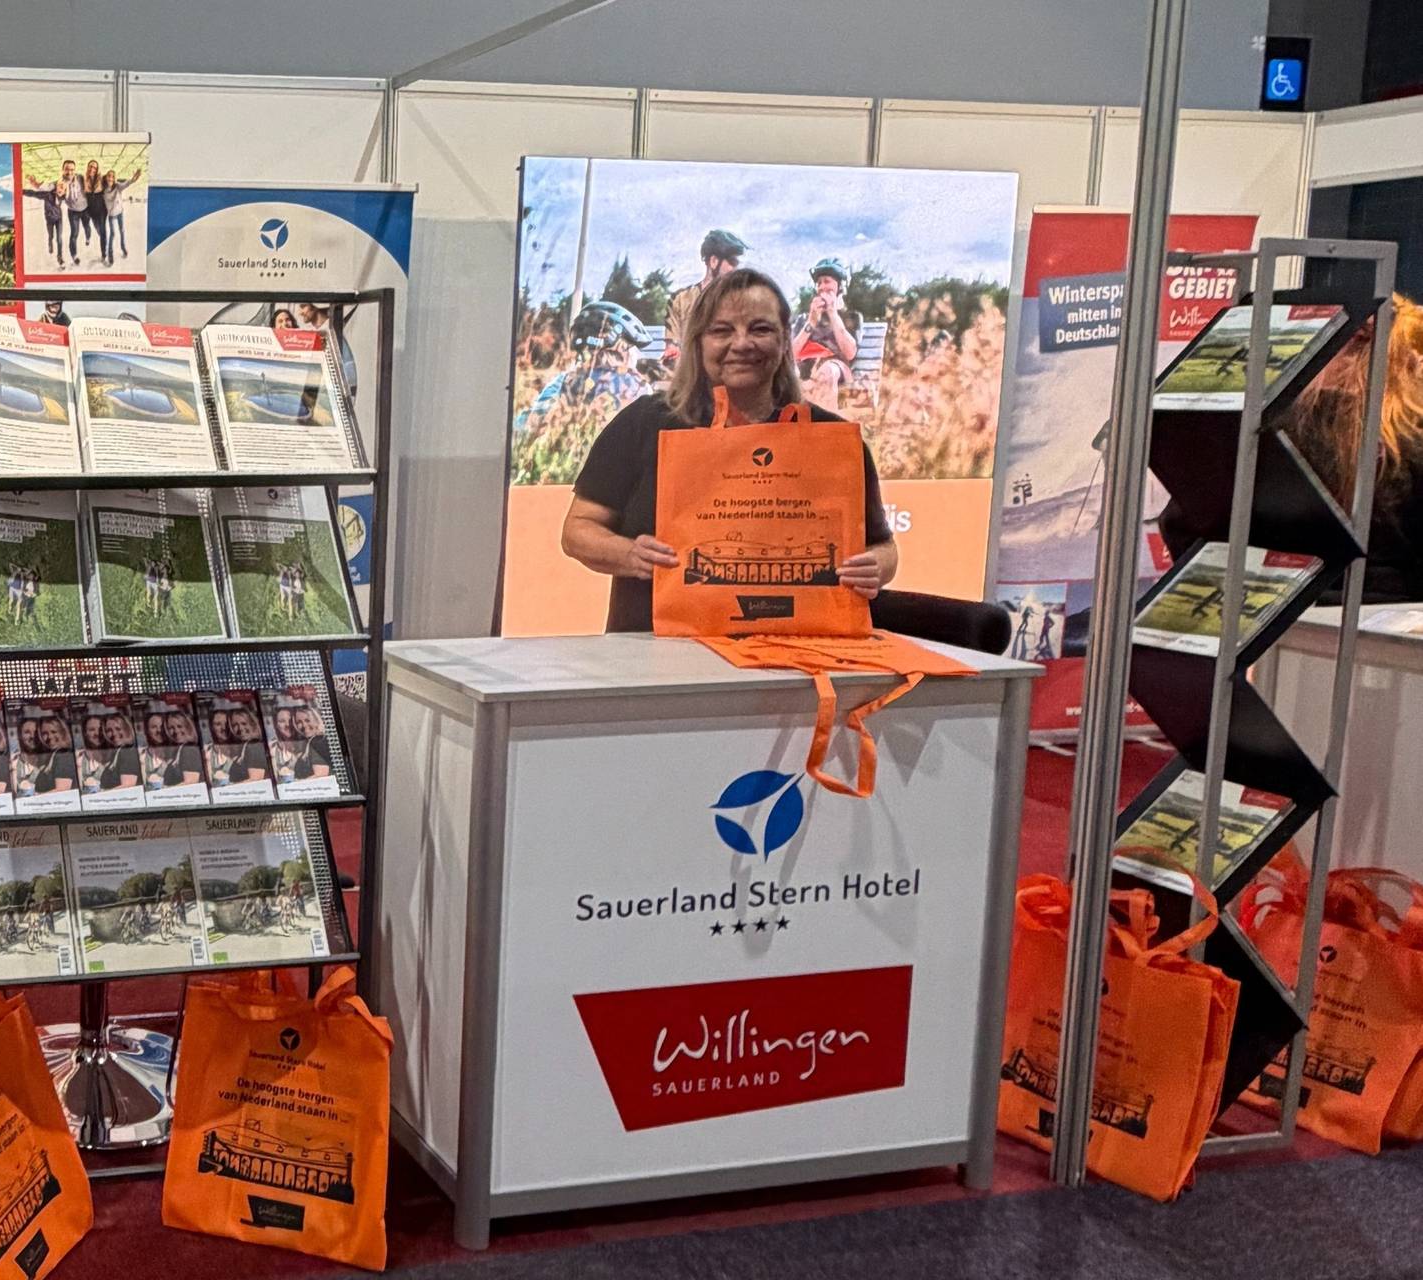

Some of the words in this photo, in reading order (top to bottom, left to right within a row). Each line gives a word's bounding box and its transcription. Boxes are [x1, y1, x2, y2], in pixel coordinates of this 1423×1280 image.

[218, 257, 268, 269] Sauerland
[271, 257, 298, 269] Stern
[300, 257, 327, 270] Hotel
[1169, 277, 1237, 300] GEBIET
[1067, 306, 1108, 324] mitten
[1055, 324, 1120, 344] Deutschla
[713, 498, 727, 508] De
[730, 497, 773, 509] hoogste
[776, 498, 812, 509] bergen
[696, 511, 716, 520] van
[718, 509, 774, 520] Nederland
[776, 510, 804, 520] staan
[806, 509, 817, 520] in
[85, 824, 139, 838] SAUERLAND
[205, 817, 257, 831] SAUERLAND
[575, 882, 737, 922] Sauerland
[748, 879, 832, 909] Stern
[842, 868, 921, 901] Hotel
[652, 1009, 870, 1080] Willingen
[237, 1076, 251, 1089] De
[252, 1078, 296, 1097] hoogste
[298, 1087, 335, 1105] bergen
[652, 1071, 780, 1096] SAUERLAND
[218, 1089, 238, 1101] van
[239, 1091, 295, 1112] Nederland
[296, 1104, 326, 1119] staan
[328, 1110, 338, 1121] in
